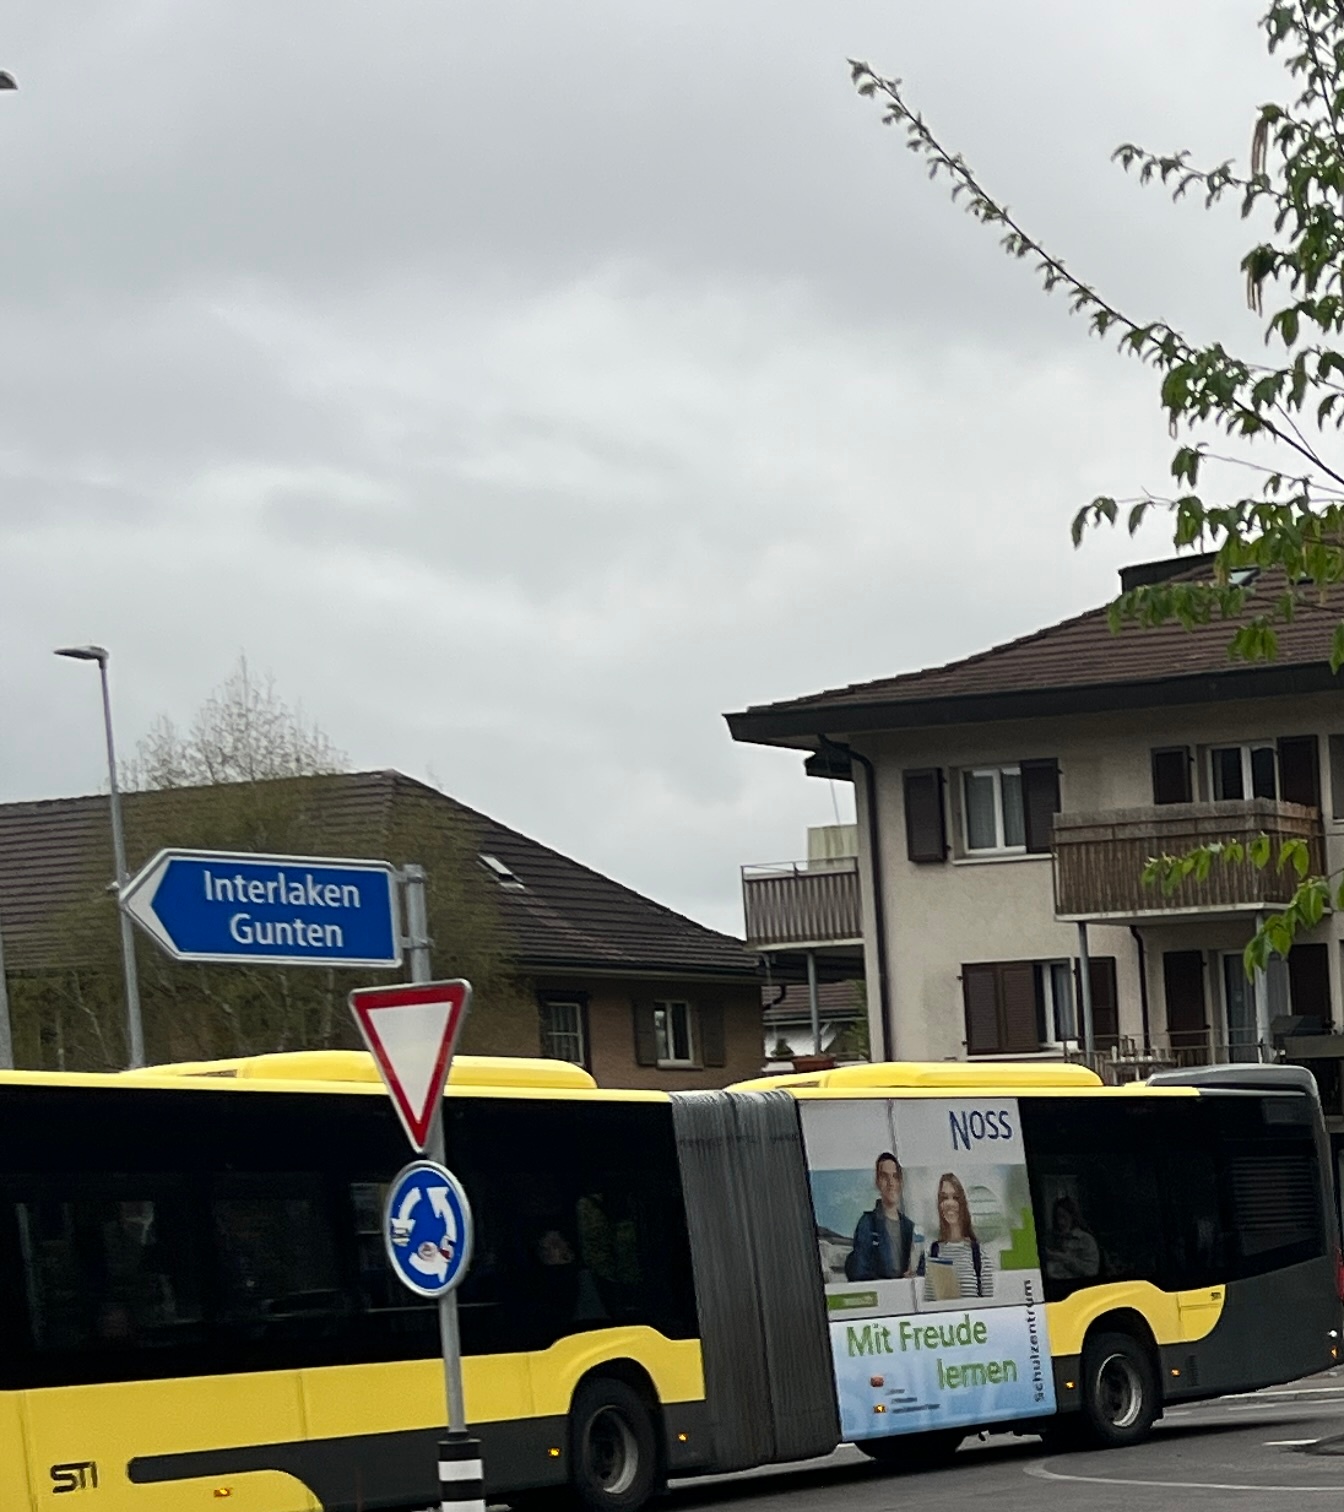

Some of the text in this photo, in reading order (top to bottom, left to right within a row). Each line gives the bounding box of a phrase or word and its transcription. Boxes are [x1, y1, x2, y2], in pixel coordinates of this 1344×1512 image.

[203, 870, 361, 908] Interlaken
[230, 912, 344, 948] Gunten
[949, 1110, 1012, 1151] NOSS
[846, 1314, 988, 1357] Mit Freude
[1024, 1279, 1045, 1402] Schulzentrum
[937, 1358, 1018, 1390] lernen
[50, 1461, 98, 1493] STI
